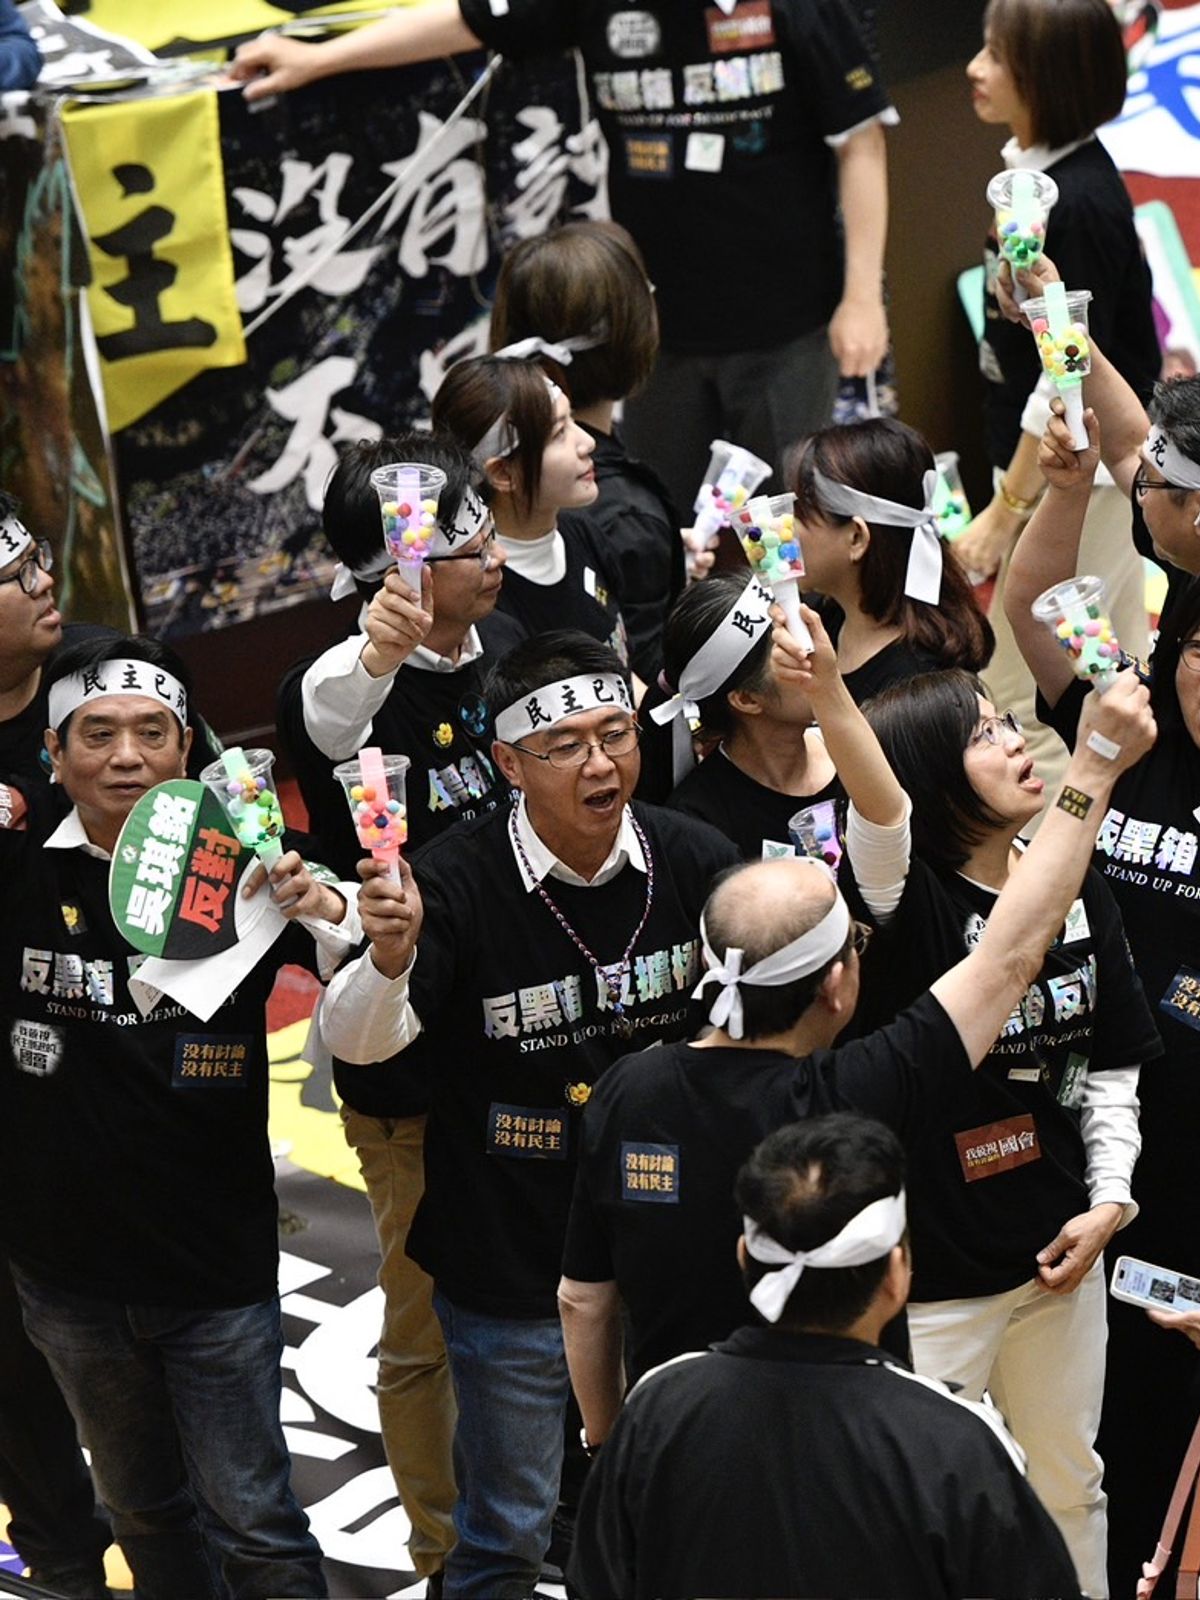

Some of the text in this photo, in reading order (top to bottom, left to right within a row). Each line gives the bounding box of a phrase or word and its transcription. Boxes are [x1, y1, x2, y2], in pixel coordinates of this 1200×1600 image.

[90, 162, 218, 362] 主
[178, 827, 243, 934] 反對
[1103, 863, 1148, 886] STAND
[1152, 876, 1173, 892] UP
[46, 1000, 88, 1020] STAND
[519, 1032, 569, 1054] STAND
[989, 1041, 1027, 1055] TAND
